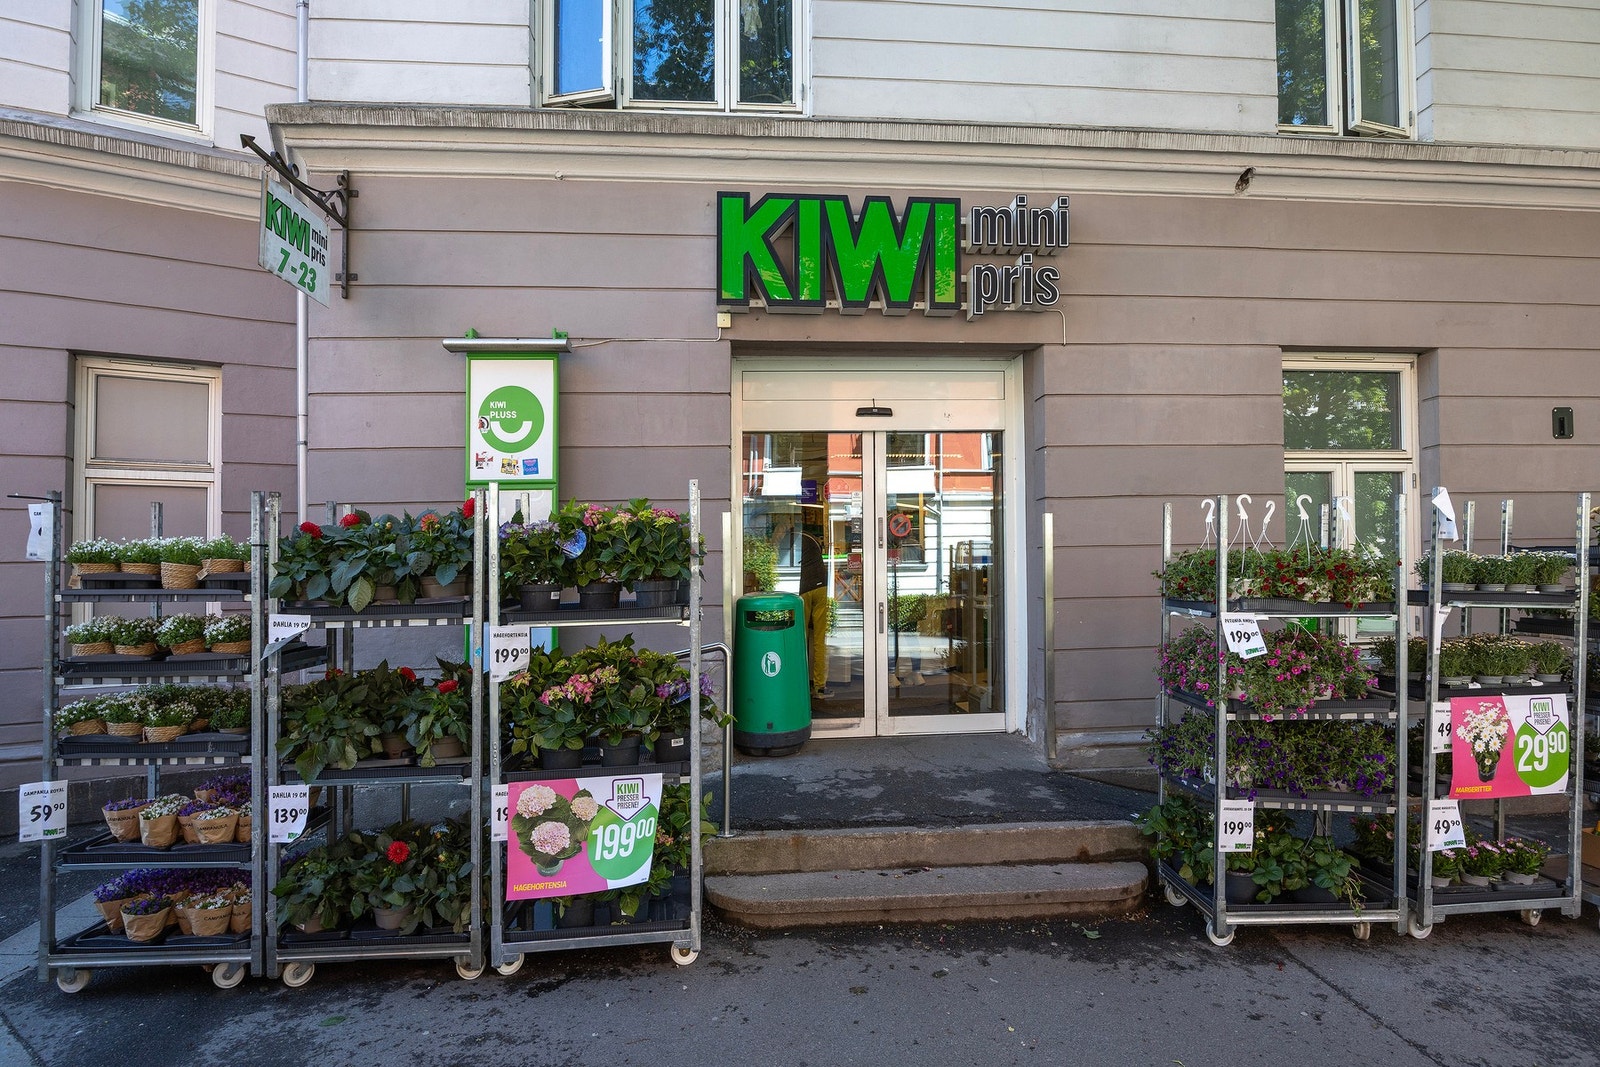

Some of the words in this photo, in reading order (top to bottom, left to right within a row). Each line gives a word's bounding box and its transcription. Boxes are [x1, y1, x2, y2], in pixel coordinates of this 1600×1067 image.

[265, 191, 311, 257] KIWI
[972, 194, 1070, 248] mini
[311, 228, 328, 251] mini
[310, 245, 327, 267] pris
[717, 191, 961, 316] KIWI
[973, 253, 1061, 315] pris
[489, 401, 507, 409] KIWI
[489, 411, 517, 419] PLUSS
[1532, 701, 1550, 712] KIWI
[616, 782, 640, 795] KIWI
[1455, 785, 1493, 794] MARGERITTER
[616, 793, 640, 803] PRESSER
[513, 880, 567, 892] HAGEHORTENSIA
